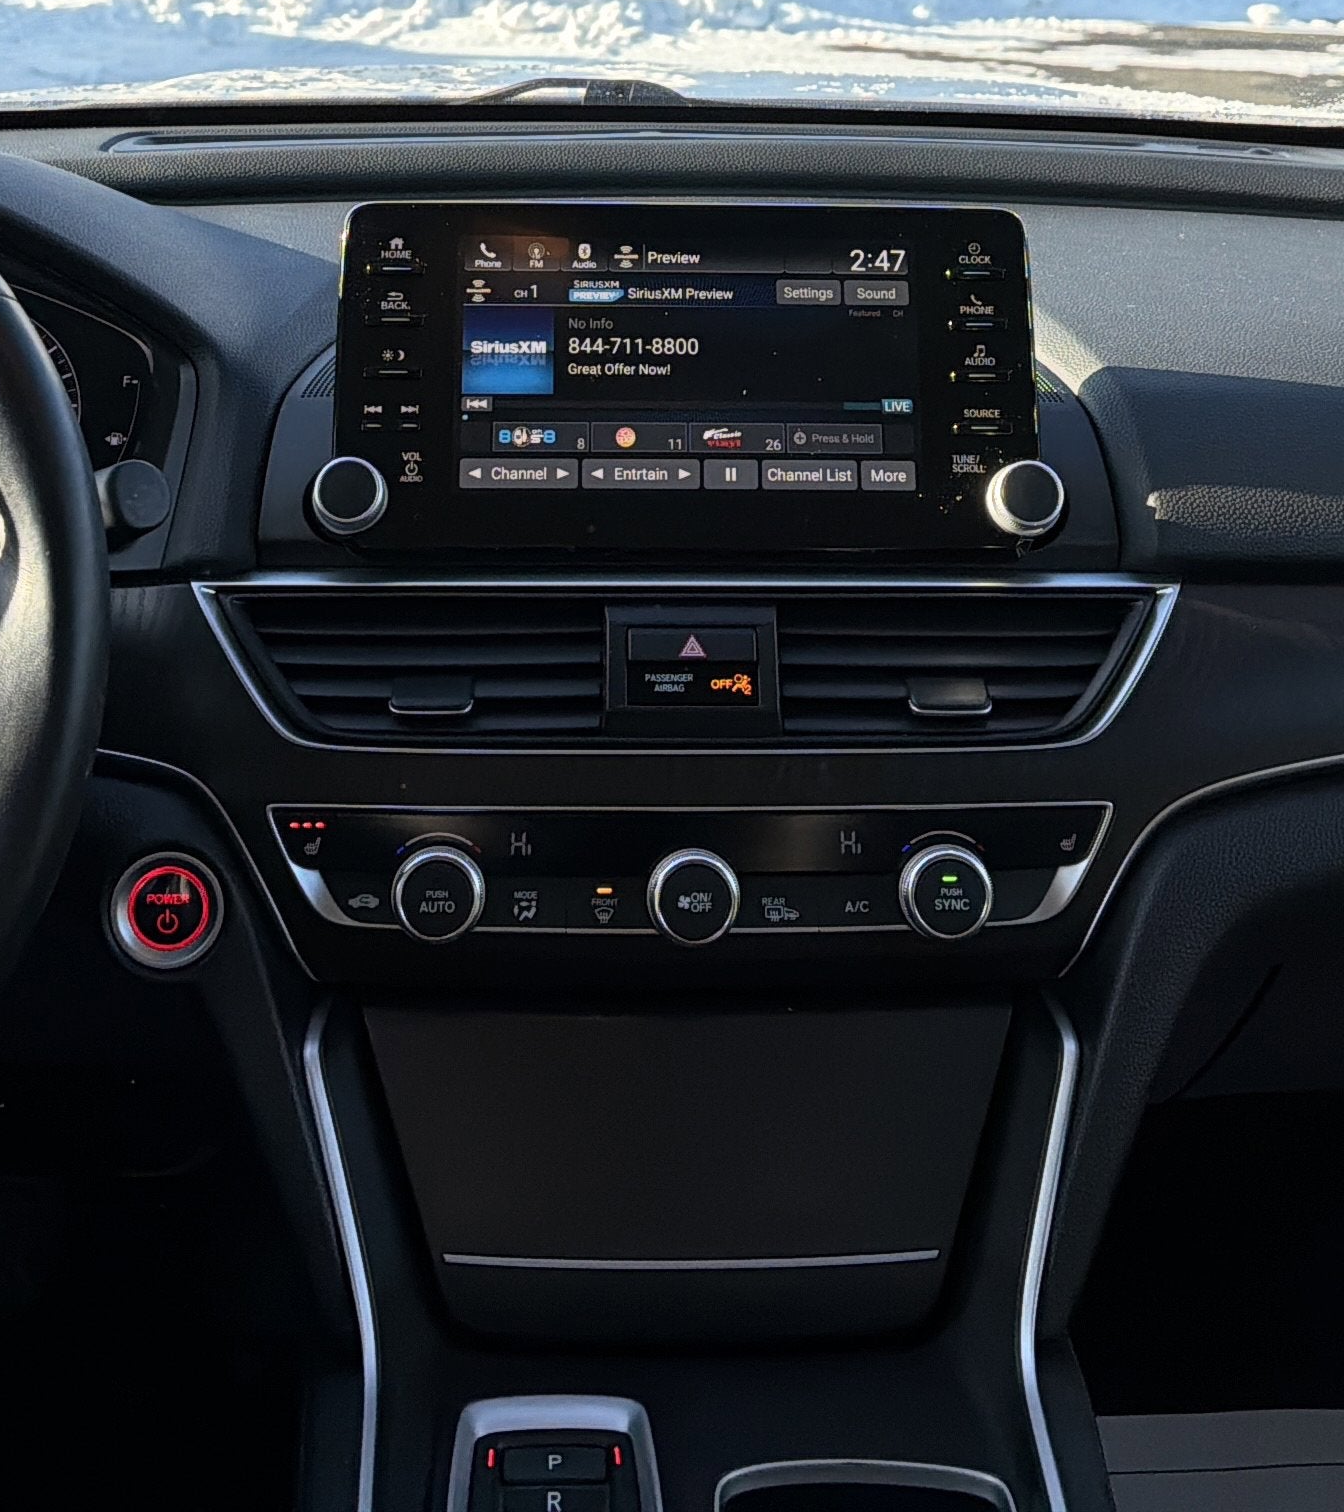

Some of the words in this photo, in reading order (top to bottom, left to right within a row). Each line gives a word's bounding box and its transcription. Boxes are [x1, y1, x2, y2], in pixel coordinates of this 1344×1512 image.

[381, 250, 412, 259] HOME
[647, 252, 701, 265] Preview
[958, 255, 992, 265] CLOCK
[474, 259, 502, 269] Phone
[529, 260, 544, 269] FM
[572, 260, 597, 269] Audio
[849, 249, 907, 272] 2:47
[514, 289, 528, 299] CH
[530, 285, 539, 298] 1
[573, 291, 618, 301] PREVIEW
[627, 288, 683, 300] SiriusXM
[685, 288, 734, 300] Preview
[783, 287, 834, 302] Settings
[856, 287, 896, 300] Sound
[381, 301, 407, 310] BACK
[960, 305, 994, 316] PHONE
[568, 318, 586, 330] No
[589, 318, 614, 330] Info
[470, 341, 547, 355] SiriusXM
[568, 338, 699, 355] 844-711-8800
[964, 357, 996, 366] AUDIO
[568, 364, 602, 375] Great
[605, 363, 636, 375] Offer
[639, 364, 671, 375] Now!
[884, 401, 911, 412] LIVE
[964, 409, 1001, 418] SOURCE
[577, 438, 585, 450] 8
[668, 438, 682, 450] 11
[765, 438, 782, 451] 26
[812, 434, 840, 444] Press
[852, 433, 874, 445] Hold
[402, 452, 422, 462] VOL
[952, 455, 980, 465] TUNE/
[490, 467, 547, 481] Channel
[952, 464, 986, 473] SCROLL
[614, 468, 668, 481] Entrtain
[767, 468, 828, 482] Channel
[830, 468, 853, 482] List
[870, 470, 907, 482] More
[645, 673, 694, 683] PASSENGER
[653, 683, 685, 693] AIRBAG
[710, 679, 733, 690] OFF
[425, 890, 449, 900] PUSH
[513, 891, 538, 900] MODE
[691, 892, 713, 903] ON/
[940, 887, 963, 897] PUSH
[146, 893, 190, 906] POWER
[591, 898, 619, 907] FRONT
[761, 896, 786, 906] REAR
[934, 898, 970, 912] SYNC
[419, 901, 456, 915] AUTO
[691, 902, 713, 913] OFF
[845, 900, 870, 914] A/C
[548, 1454, 563, 1470] P
[547, 1491, 562, 1511] R
